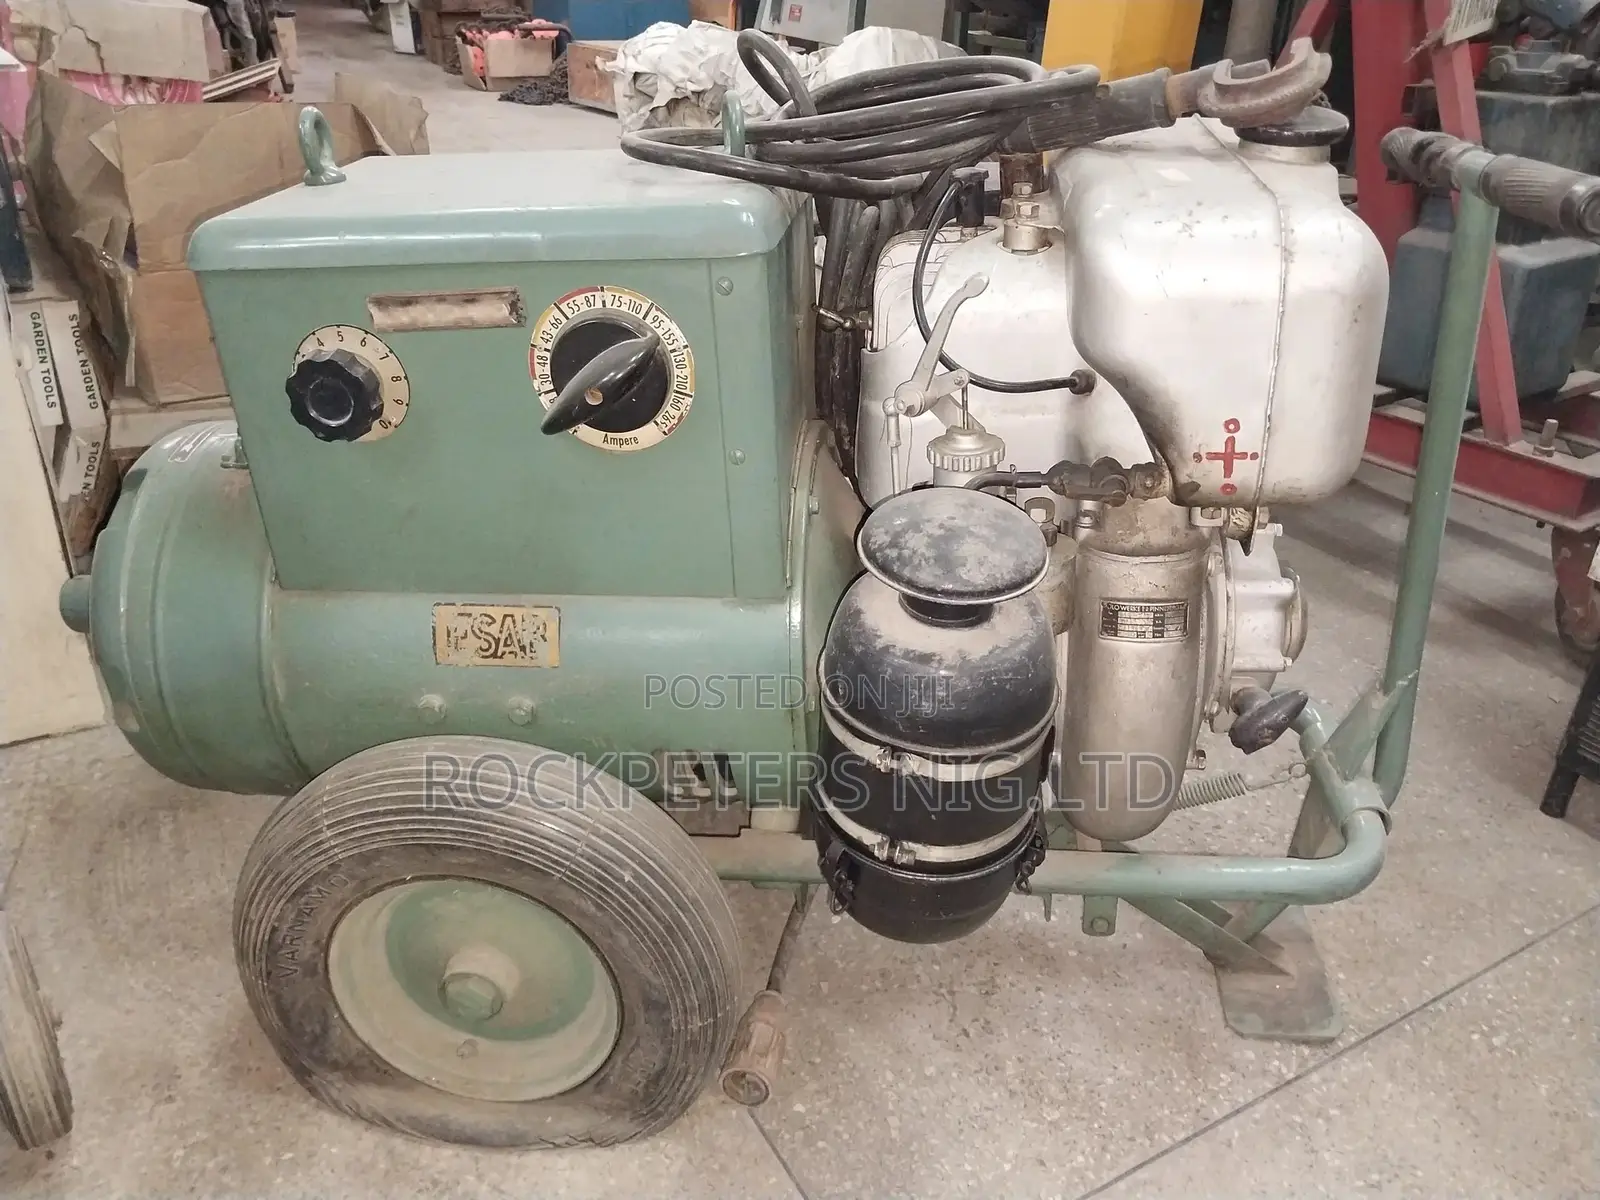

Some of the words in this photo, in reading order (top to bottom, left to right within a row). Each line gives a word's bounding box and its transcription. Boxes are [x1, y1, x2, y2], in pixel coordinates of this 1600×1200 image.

[566, 295, 596, 315] 55-87
[610, 294, 643, 315] 75-110
[68, 313, 85, 356] TOOLS
[337, 331, 344, 342] 5
[540, 315, 563, 344] 43-66
[650, 314, 679, 346] 95-155
[316, 337, 325, 348] 4
[360, 337, 367, 347] 6
[30, 311, 49, 364] GARDEN
[41, 368, 57, 409] TOOLS
[379, 352, 390, 361] 7
[390, 375, 402, 383] 8
[536, 355, 552, 386] 30-48
[673, 352, 689, 390] 130-210
[78, 359, 99, 410] GARDEN
[392, 398, 404, 406] 9
[602, 433, 640, 448] Ampere
[83, 441, 101, 479] TOOLS
